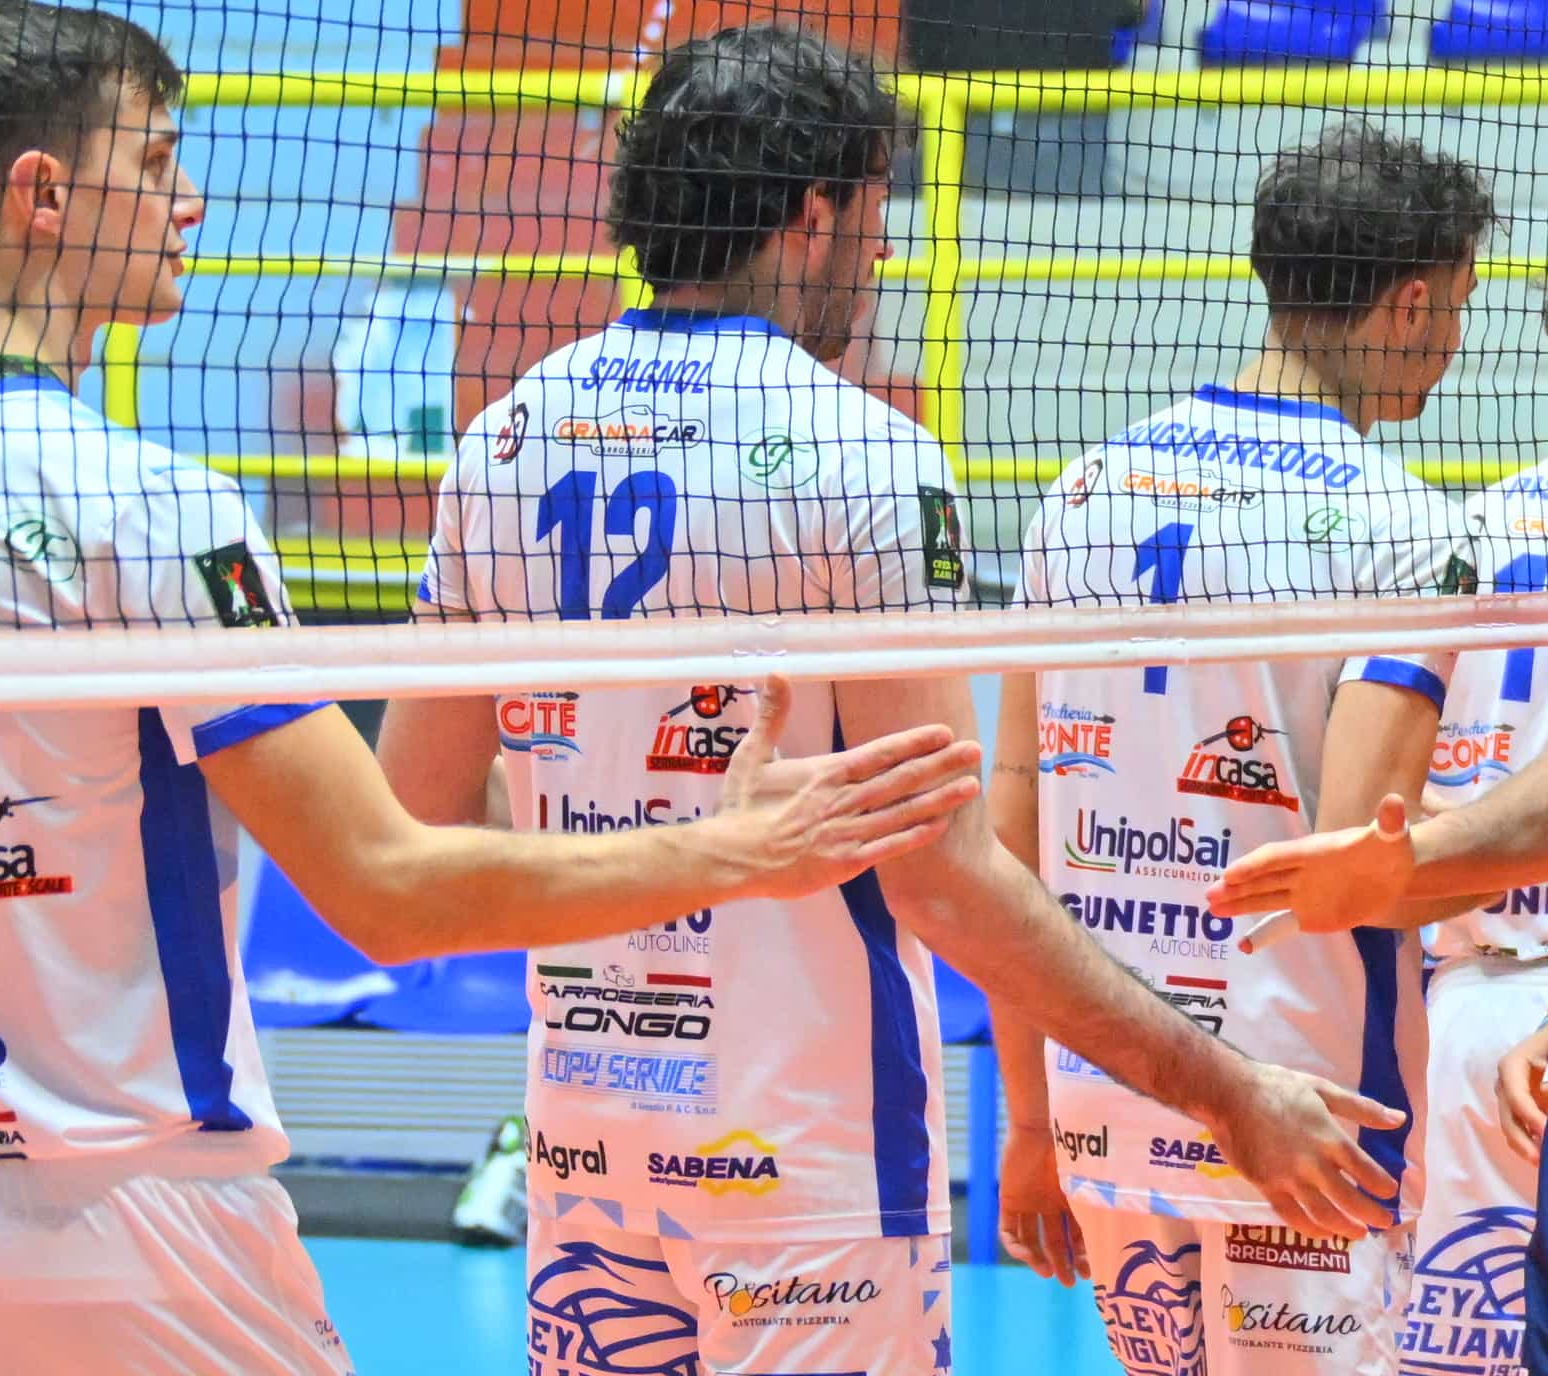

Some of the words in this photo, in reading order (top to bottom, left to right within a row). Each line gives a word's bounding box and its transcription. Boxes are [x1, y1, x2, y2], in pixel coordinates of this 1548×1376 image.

[581, 356, 712, 394] SPAGNOL
[558, 420, 698, 443] GRANDACAR
[1123, 473, 1256, 506] GRANDACAR
[535, 470, 678, 621] 12
[1131, 522, 1195, 695] 1
[1182, 744, 1280, 792] incasa
[1076, 808, 1232, 875] UnipolSai
[1059, 892, 1234, 942] GUNETTO
[628, 935, 710, 955] AUTOLINEE
[1149, 939, 1229, 961] AUTOLINEE
[540, 981, 715, 1009] CARROZZERIA
[545, 1006, 711, 1041] LONGO
[544, 1047, 602, 1086] COPY
[607, 1054, 709, 1096] SERVICE
[536, 1130, 608, 1180] Agral
[1055, 1118, 1108, 1162] Agral
[1149, 1136, 1228, 1164] SABE
[647, 1152, 780, 1180] SABENA
[731, 1316, 794, 1328] RISTORANTE
[797, 1315, 851, 1326] PIZZERIA
[1286, 1340, 1334, 1354] PIZZERIA
